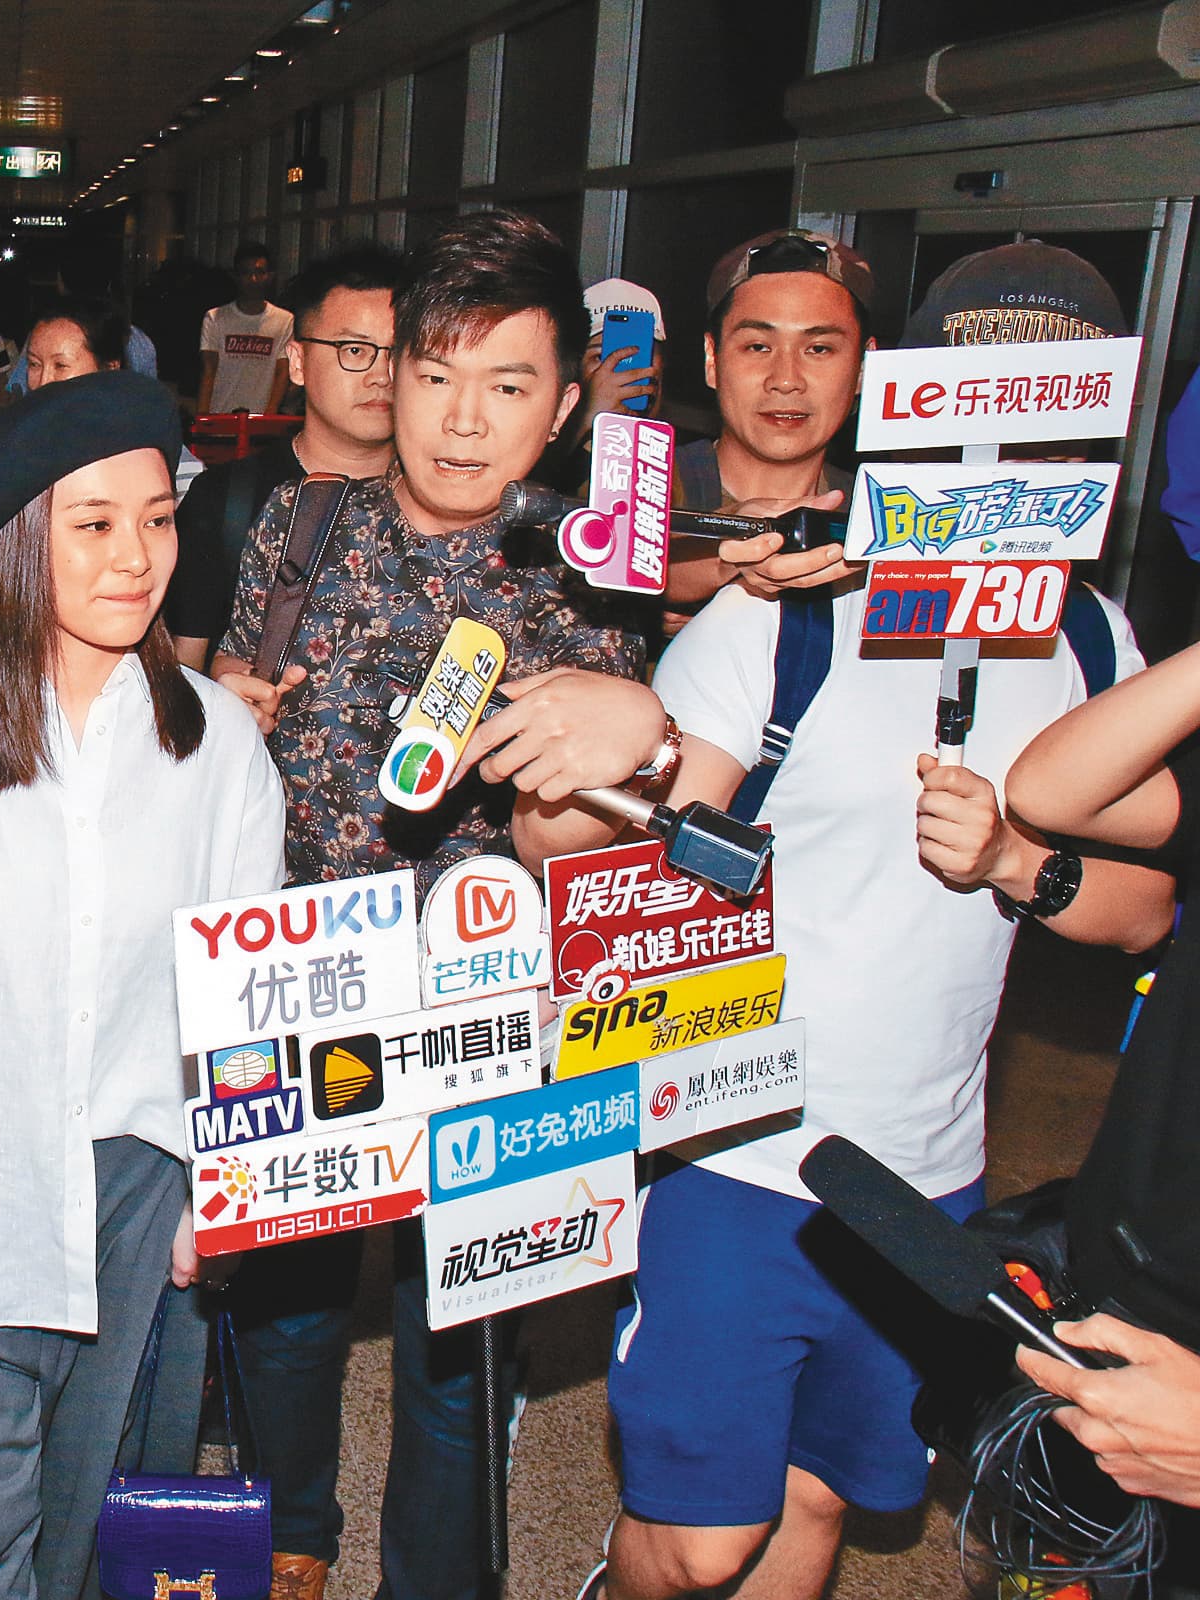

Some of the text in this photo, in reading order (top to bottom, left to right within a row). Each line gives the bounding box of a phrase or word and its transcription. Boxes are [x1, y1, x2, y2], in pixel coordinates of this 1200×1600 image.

[1000, 294, 1079, 313] LOS ANGELES
[228, 337, 271, 353] Dickies
[953, 372, 1113, 417] 乐视视频
[999, 541, 1053, 553] 腾讯视频
[191, 884, 402, 960] YOUKU
[611, 908, 771, 973] 新娱乐在线
[238, 950, 366, 1031] 优酷
[384, 1010, 532, 1074] 千帆直播
[566, 990, 778, 1051] sina 新浪娱乐
[444, 1058, 534, 1089] 搜狐旗下
[685, 1076, 799, 1111] ent.ifeng.com
[195, 1090, 301, 1149] MATV
[500, 1090, 636, 1162] 好兔视频
[451, 1163, 482, 1179] HOW
[256, 1202, 373, 1243] wasu.cn
[440, 1207, 598, 1291] 视觉星动
[442, 1270, 558, 1312] VisualStar
